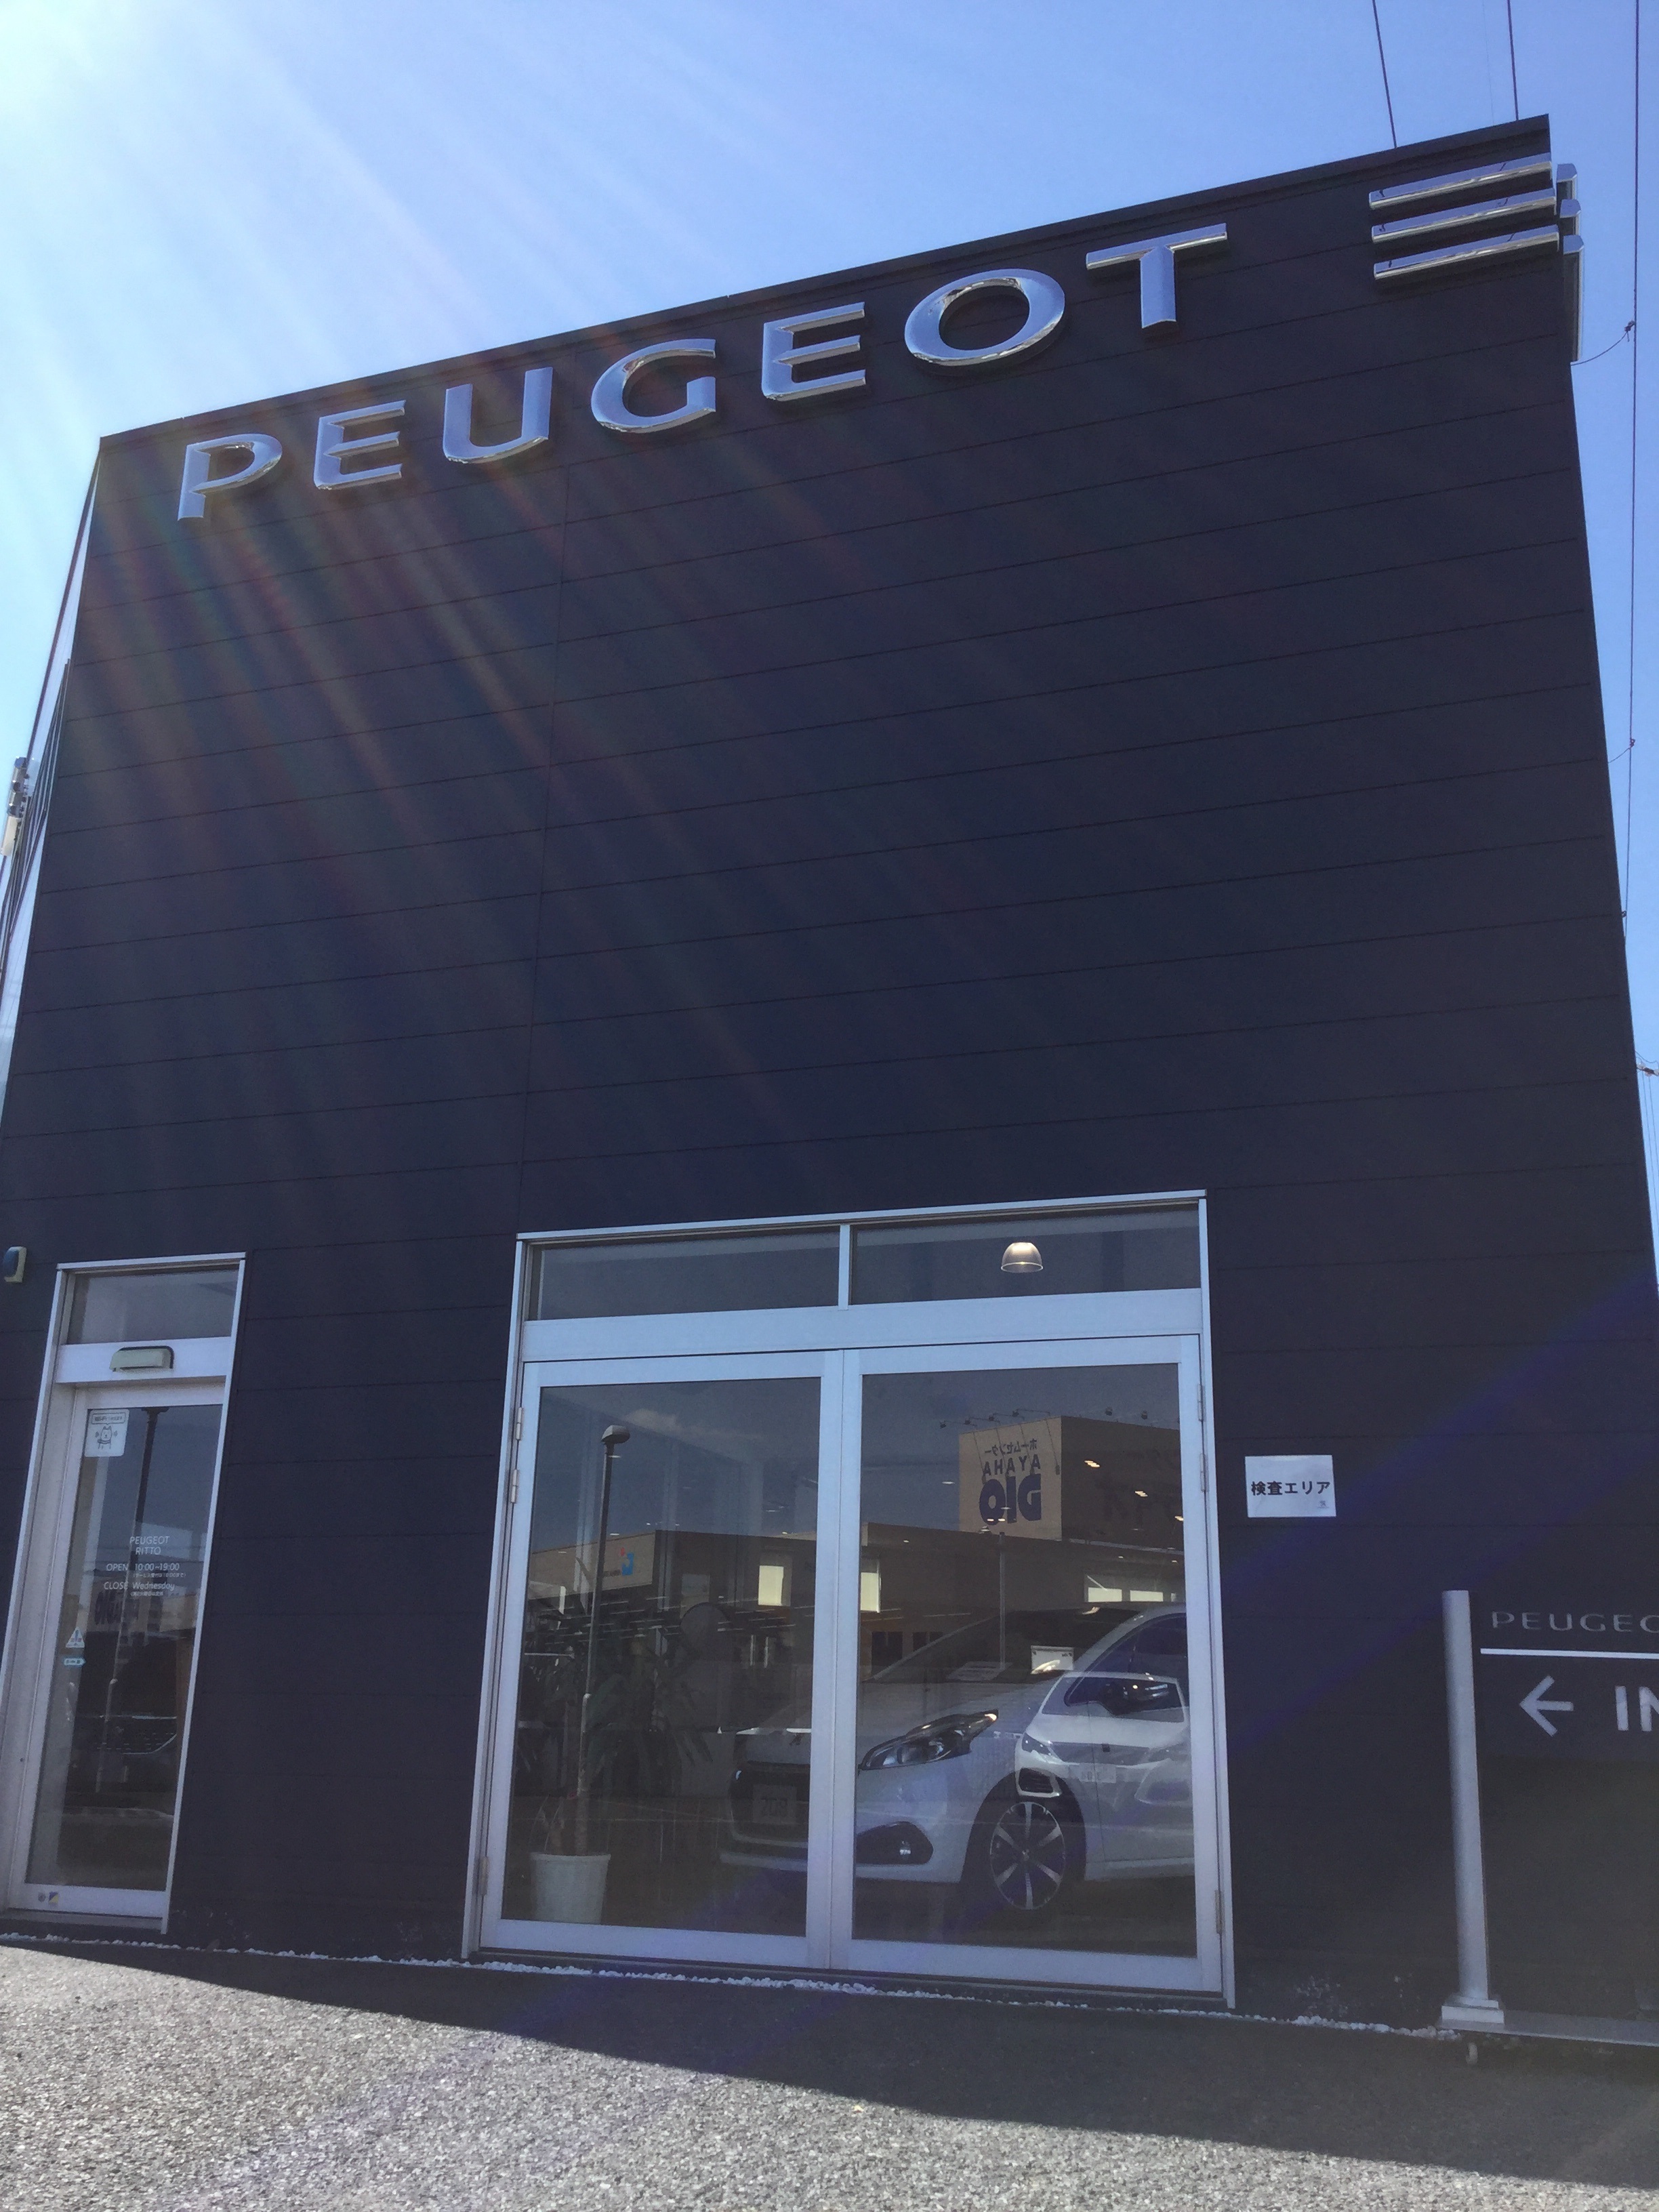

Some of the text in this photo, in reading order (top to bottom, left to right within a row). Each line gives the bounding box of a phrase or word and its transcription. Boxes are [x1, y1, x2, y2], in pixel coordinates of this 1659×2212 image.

[178, 224, 1227, 520] PEUGEOT
[1251, 1481, 1330, 1496] 検査エリア
[129, 1536, 169, 1544] PEUGEOT
[136, 1547, 161, 1555] RITTO
[106, 1563, 128, 1572] OPEN
[104, 1581, 175, 1591] CLOSE Wednesday
